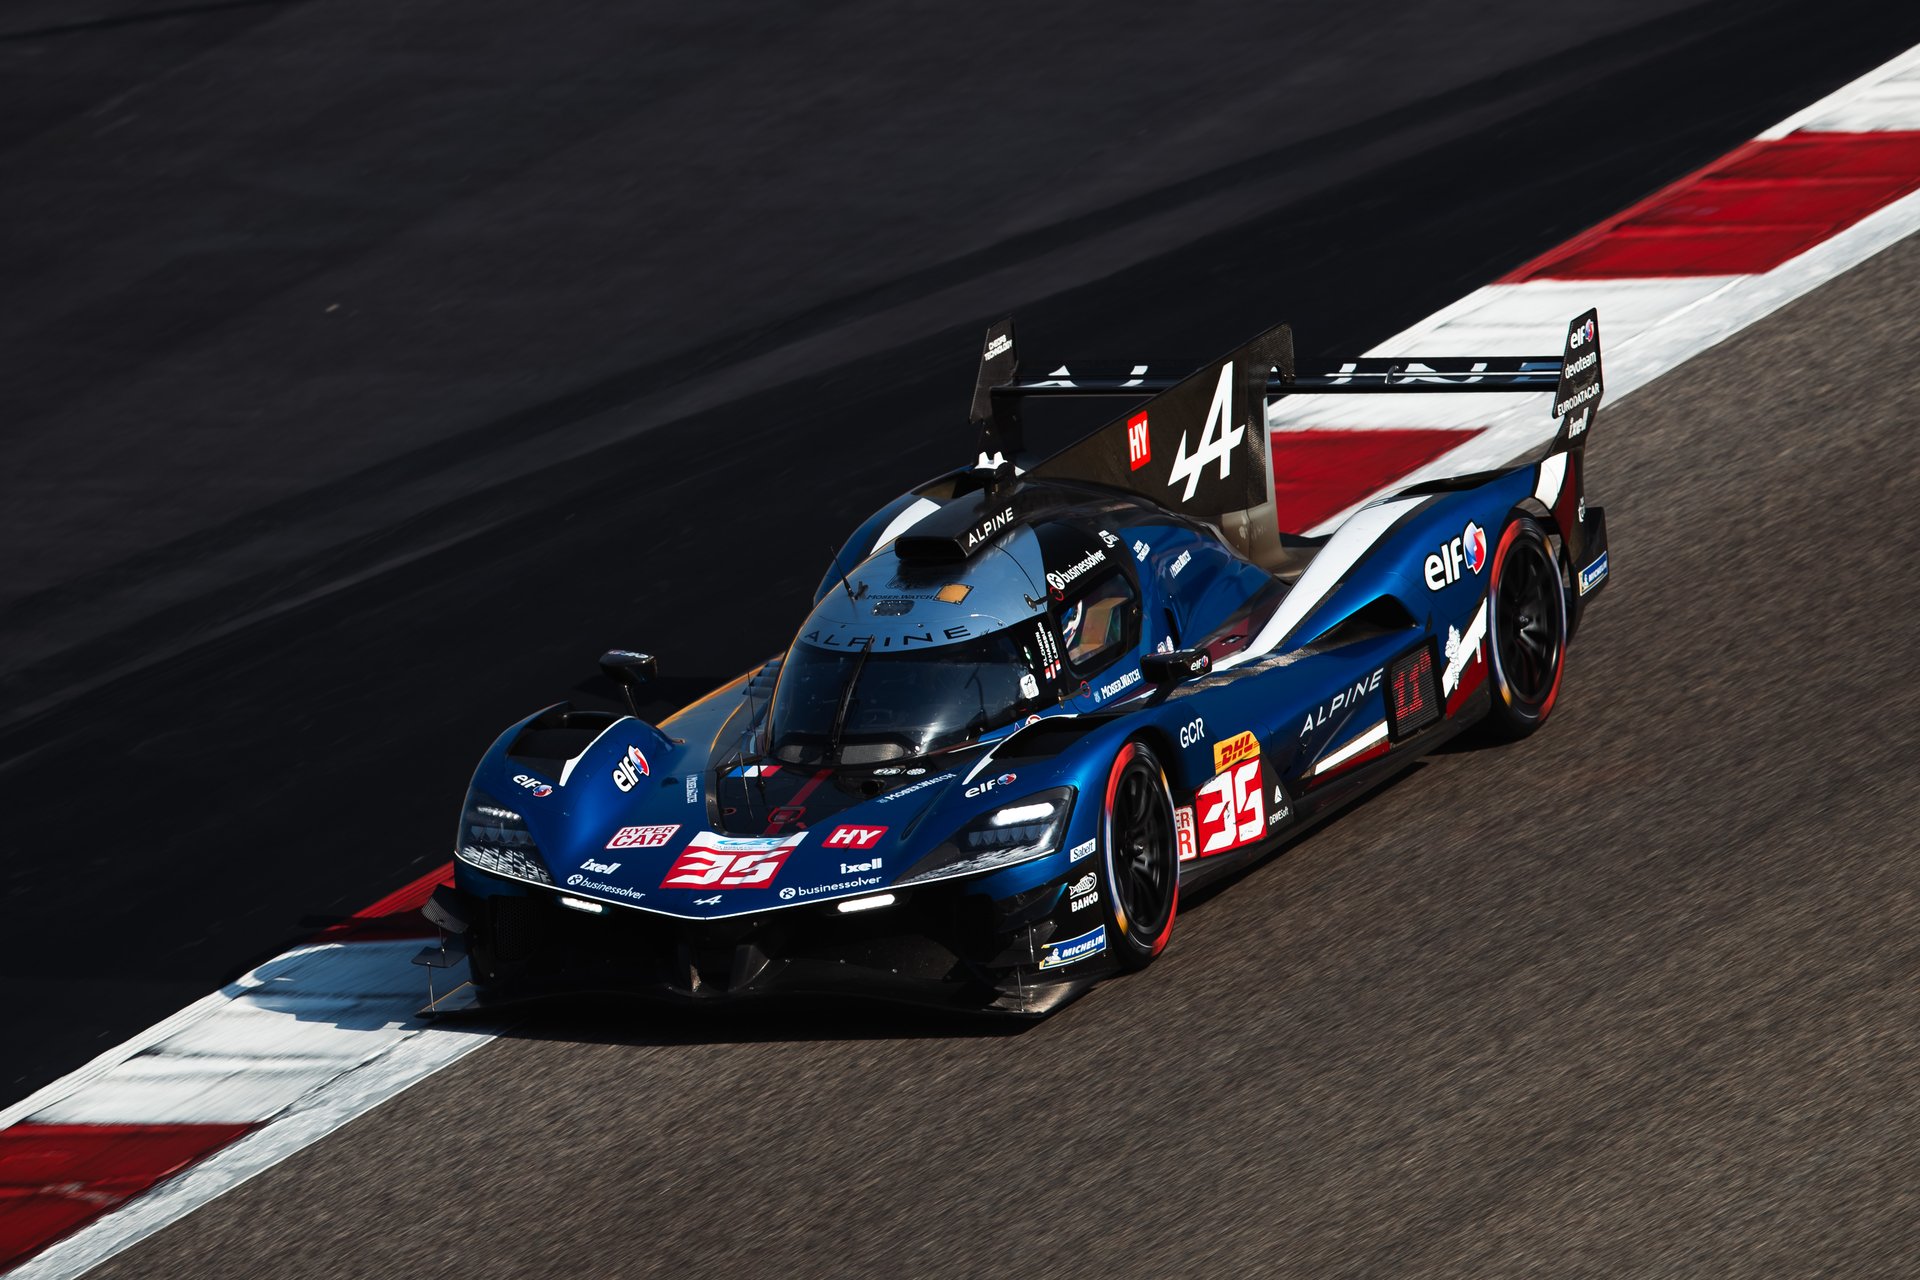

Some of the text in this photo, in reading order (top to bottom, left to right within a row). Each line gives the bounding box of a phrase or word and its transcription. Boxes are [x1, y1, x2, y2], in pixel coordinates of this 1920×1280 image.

[1570, 326, 1586, 349] elf
[1565, 352, 1597, 379] devoteam
[1558, 383, 1600, 416] EURODATACAR
[1568, 407, 1589, 439] ixell
[1129, 420, 1148, 462] HY
[968, 507, 1014, 547] ALPINE
[1060, 548, 1106, 583] businessolver
[1425, 533, 1465, 592] elf
[1190, 660, 1202, 671] elf
[1300, 668, 1385, 737] ALPINE
[1180, 718, 1204, 748] GCR
[1222, 733, 1254, 765] DHL
[512, 774, 538, 788] elf
[612, 758, 636, 792] elf
[964, 780, 996, 799] elf
[1197, 760, 1264, 852] 35
[614, 834, 667, 848] CAR
[620, 826, 674, 835] HYPER
[829, 828, 880, 845] HY
[1073, 840, 1095, 861] Sabelt
[580, 858, 621, 875] ixell
[666, 850, 789, 886] 35
[840, 858, 882, 874] ixell
[580, 876, 646, 901] businessolver
[798, 876, 882, 897] businessolver
[1071, 891, 1099, 913] BAHCO
[1062, 934, 1104, 958] MICHELIN
